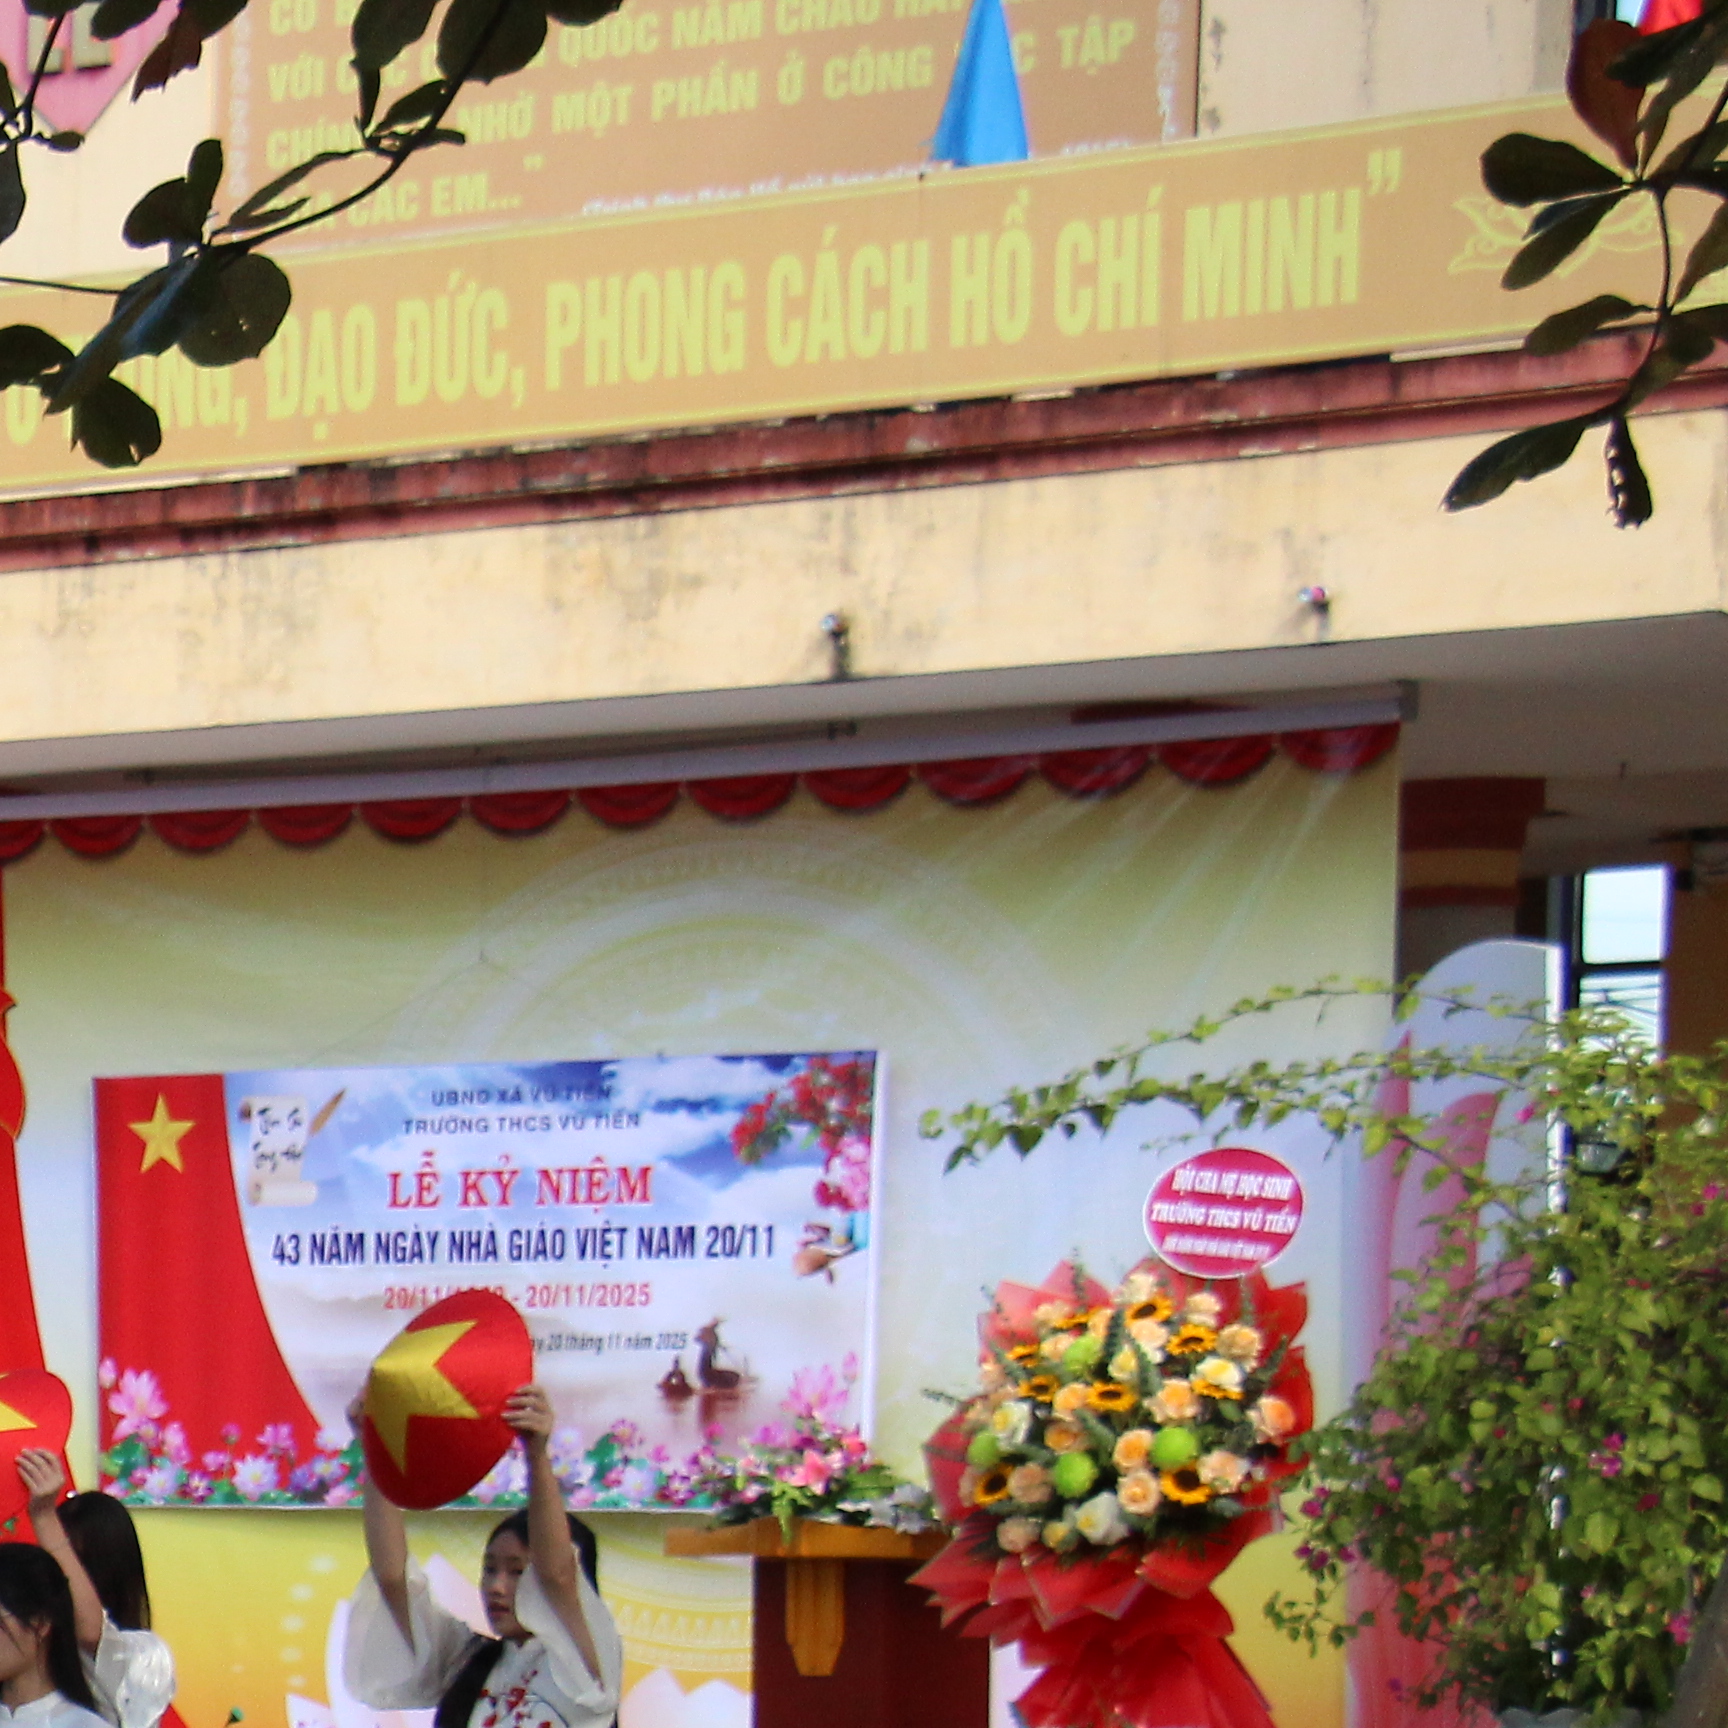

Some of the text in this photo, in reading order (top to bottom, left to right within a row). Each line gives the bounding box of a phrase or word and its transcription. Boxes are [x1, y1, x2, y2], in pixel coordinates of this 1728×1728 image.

[264, 303, 377, 441] ĐẠO
[394, 268, 527, 410] ĐỨC,
[544, 260, 744, 391] PHONG
[764, 225, 931, 368] CÁCH
[949, 186, 1033, 348] HỒ
[1052, 183, 1165, 337] CHÍ
[403, 1112, 490, 1135] TRƯỜNG
[497, 1113, 551, 1133] THCS
[387, 1149, 655, 1214] LỄ KỶ NIỆM
[271, 1219, 774, 1270] 43 NĂM NGÀY NHÀ GIÁO VIỆT NAM 20/11
[525, 1282, 652, 1309] 20/11/2025
[656, 1332, 689, 1350] 2025
